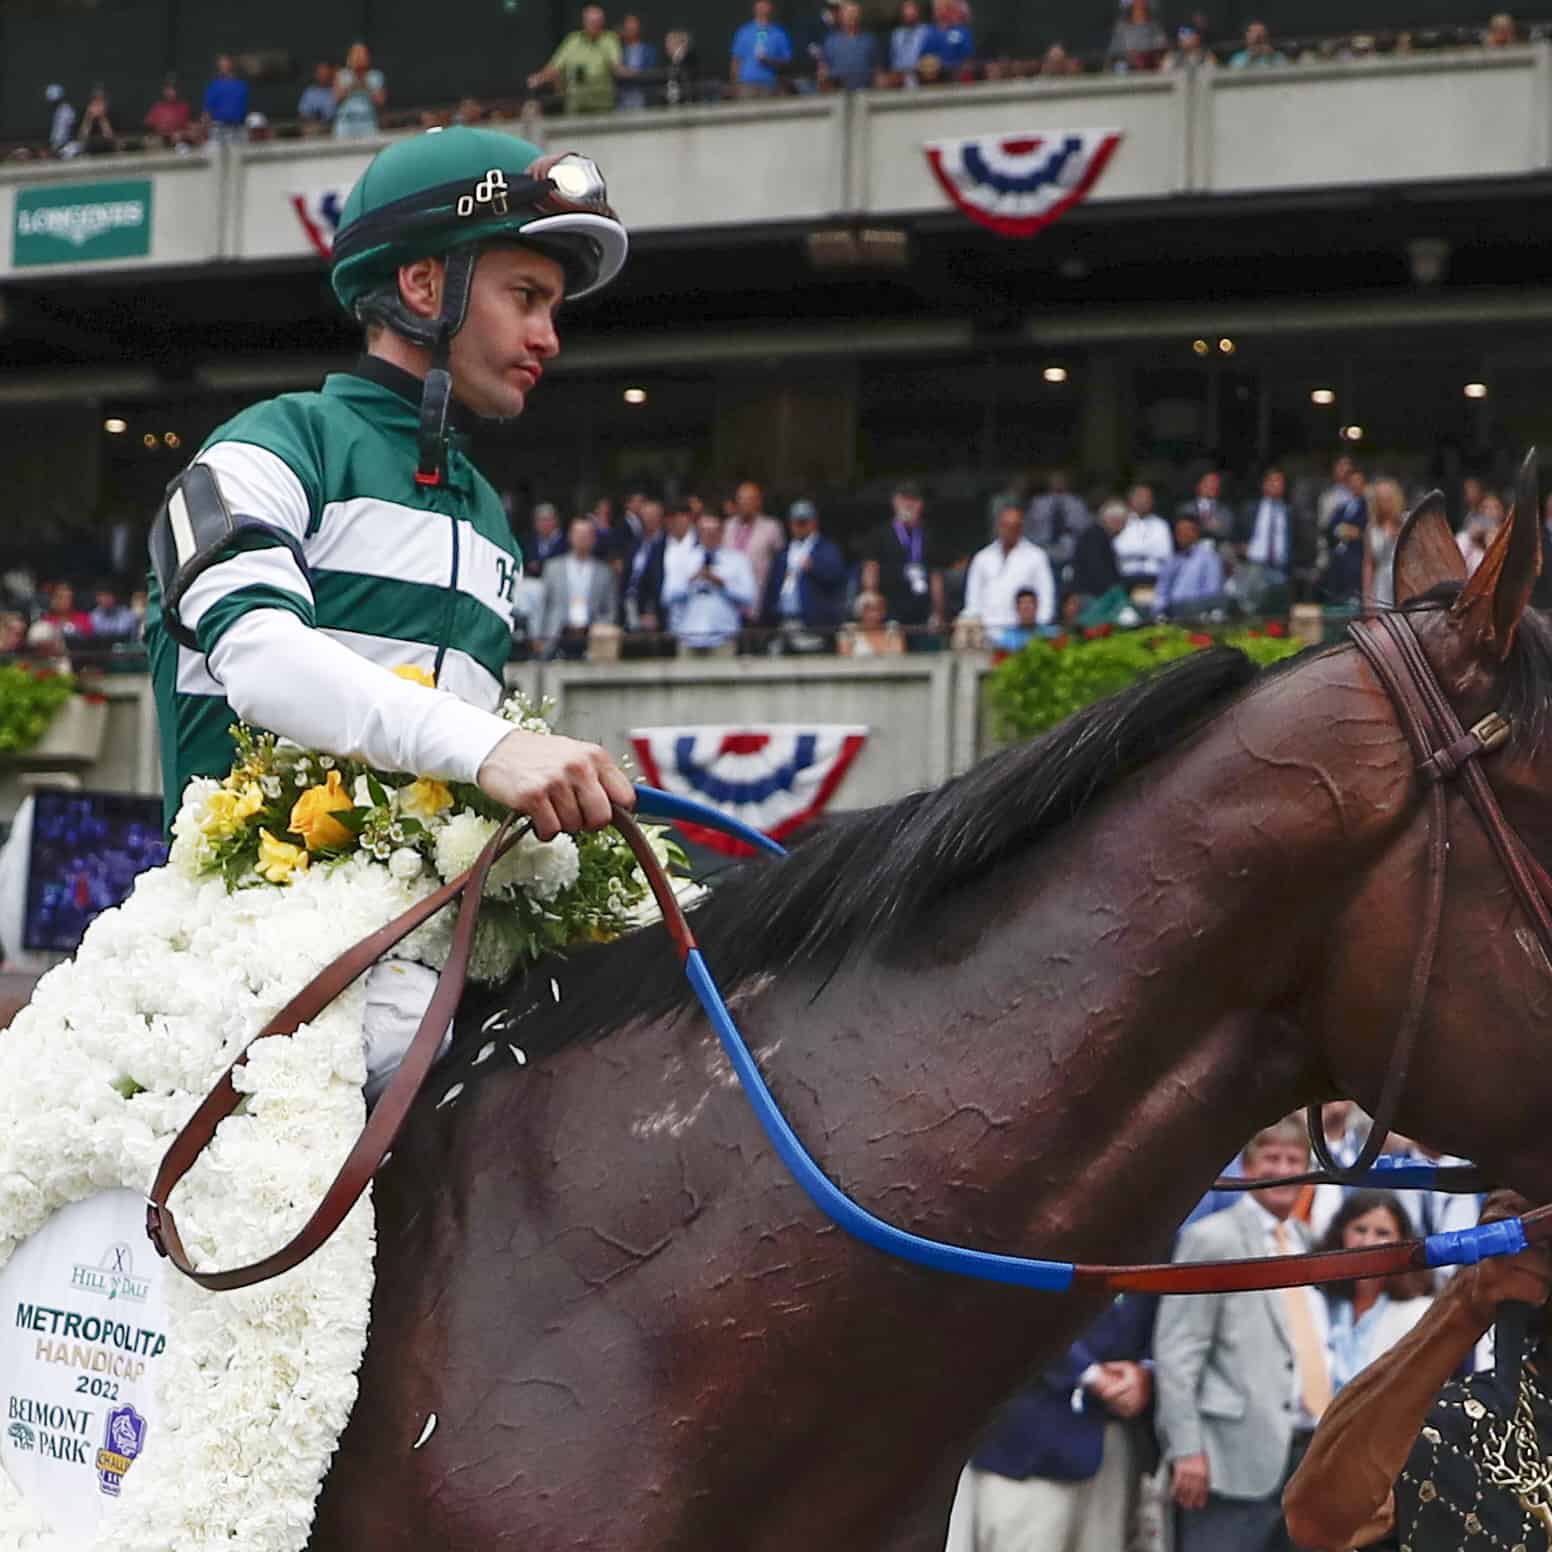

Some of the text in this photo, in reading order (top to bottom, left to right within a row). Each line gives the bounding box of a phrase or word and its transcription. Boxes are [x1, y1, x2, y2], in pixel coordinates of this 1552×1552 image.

[72, 1266, 105, 1289] HILL
[35, 1338, 145, 1382] HANDICAP
[75, 1375, 119, 1401] 2022
[8, 1396, 94, 1435] BELMONT
[38, 1431, 91, 1464] PARK
